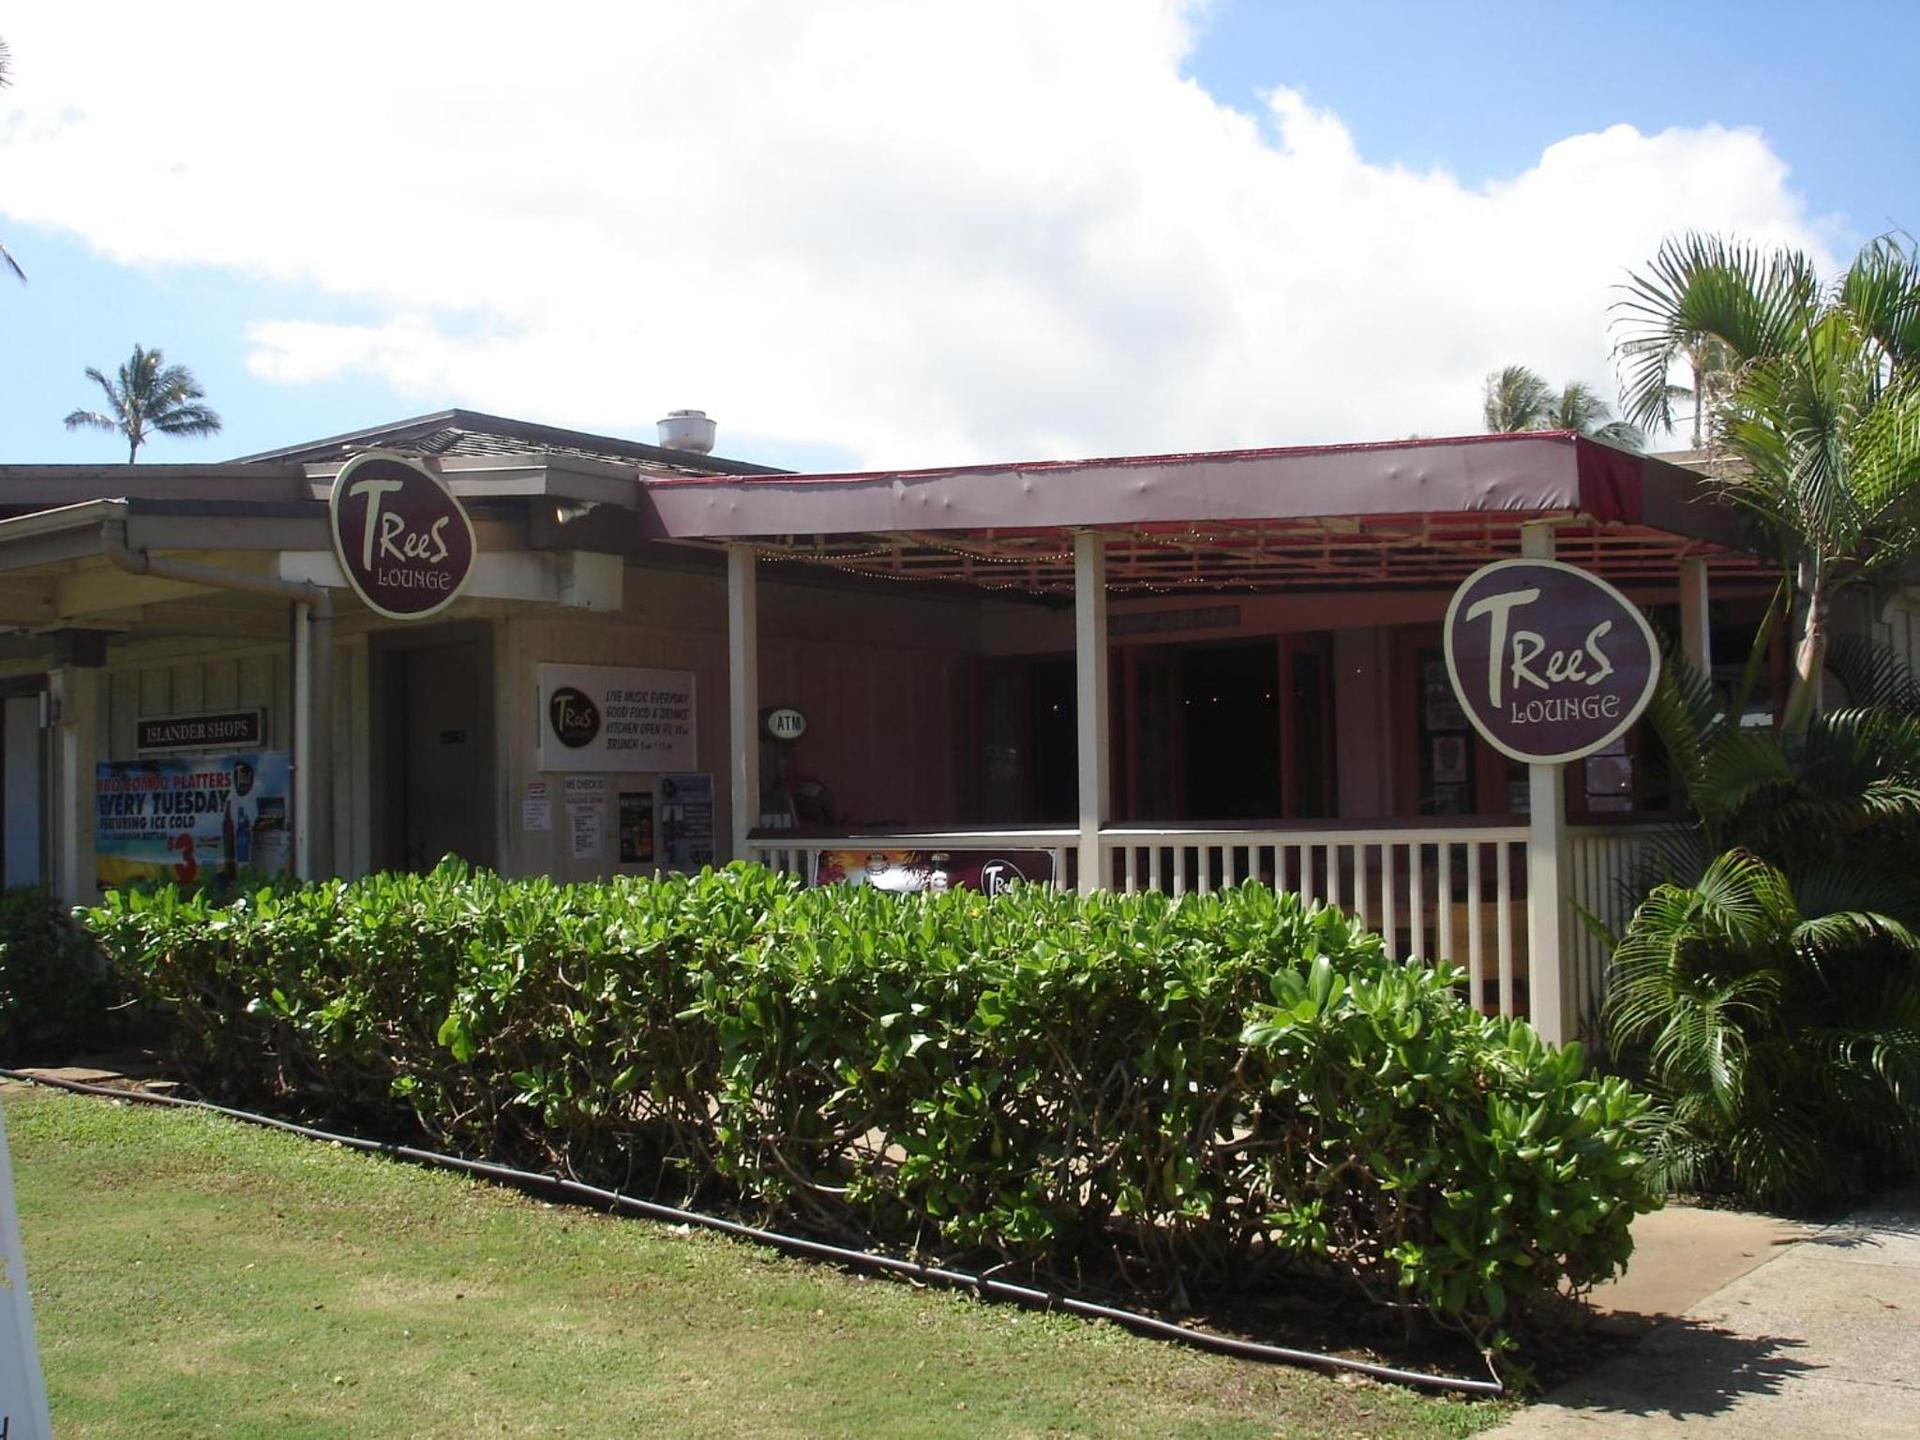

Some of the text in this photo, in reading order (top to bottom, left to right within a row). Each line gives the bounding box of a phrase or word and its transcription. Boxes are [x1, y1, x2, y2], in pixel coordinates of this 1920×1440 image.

[378, 567, 450, 590] LOUNGE
[1511, 694, 1621, 724] LOUNGE
[147, 719, 249, 743] ISLANDER SHOPS
[777, 716, 801, 731] ATM
[175, 772, 232, 790] PLATTERS
[100, 790, 231, 816] EVERY TUESDAY
[150, 815, 168, 829] ICE
[169, 815, 196, 829] COLD
